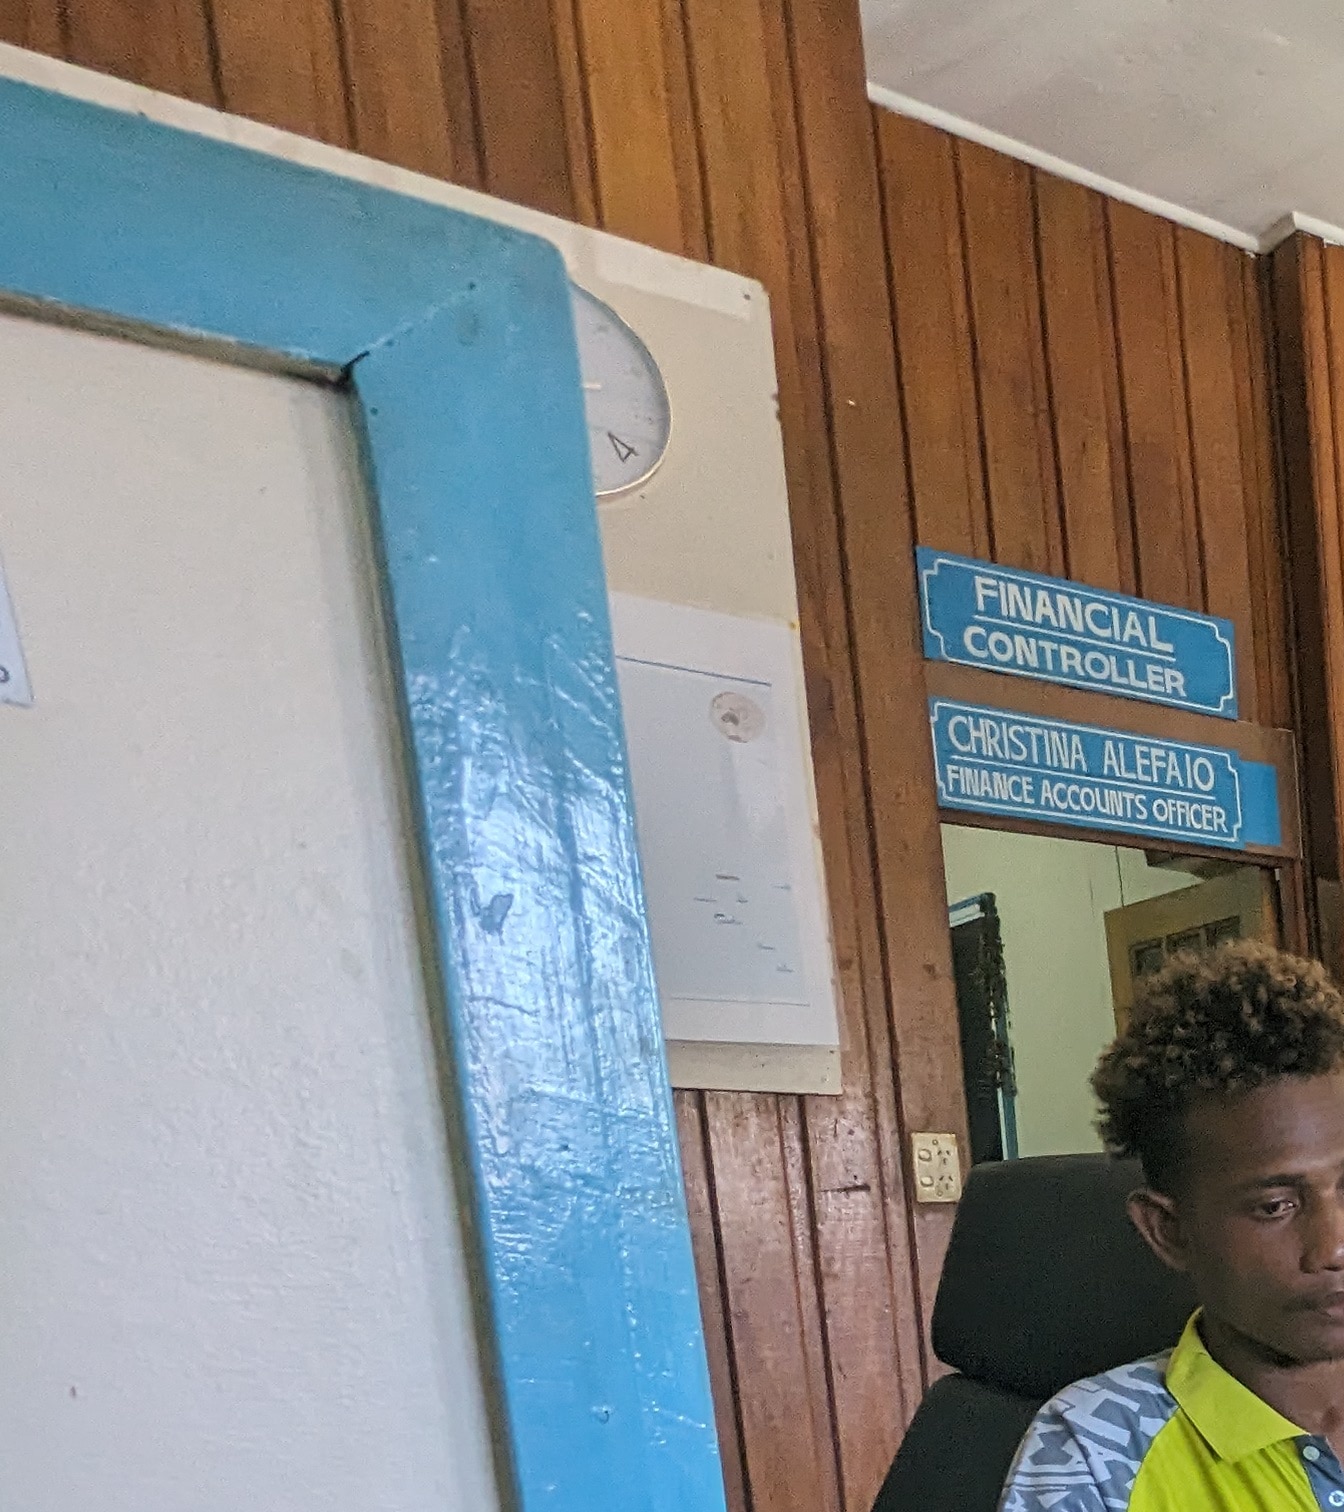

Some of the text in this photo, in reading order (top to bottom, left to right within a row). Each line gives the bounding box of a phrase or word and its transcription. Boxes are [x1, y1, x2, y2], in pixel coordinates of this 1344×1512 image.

[608, 431, 640, 463] 4
[974, 576, 1174, 652] FINANCIAL
[963, 626, 1187, 697] CONTROLLER
[949, 716, 1215, 791] CHRISTINA ALEFAIO
[948, 765, 1228, 832] FINANCE ACCOUNTS OFFICER
